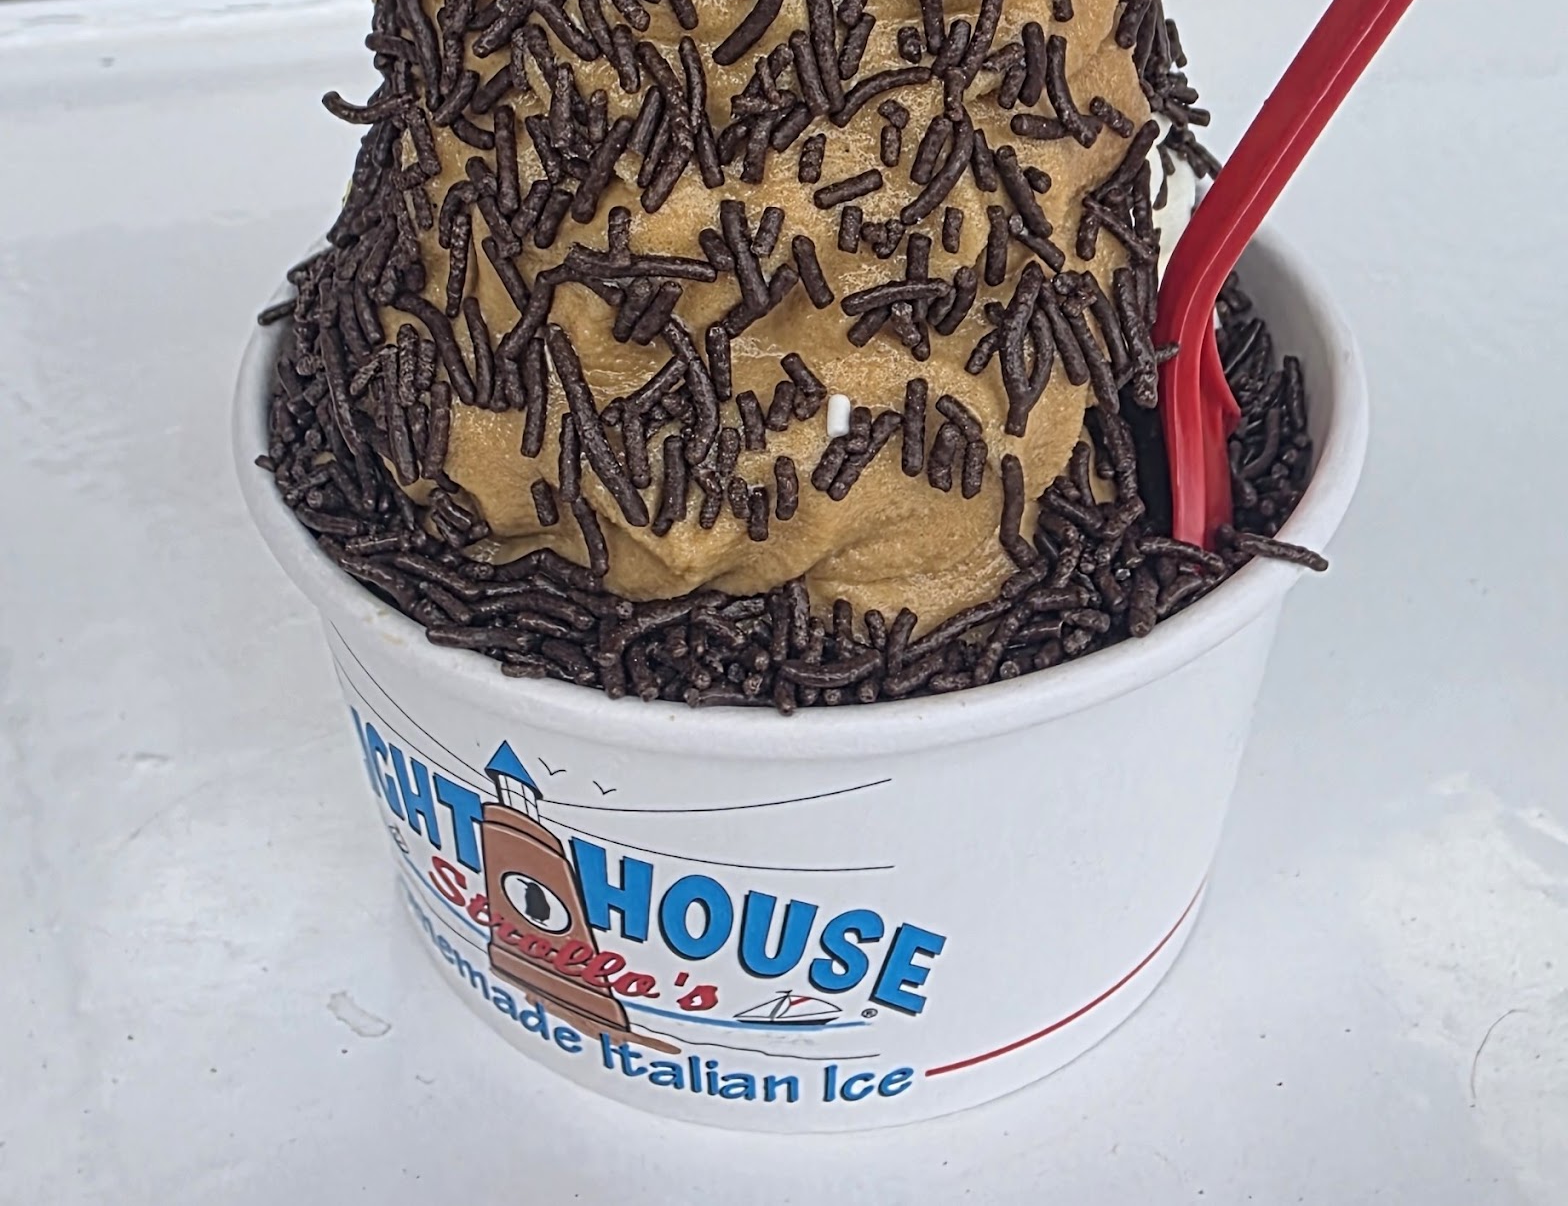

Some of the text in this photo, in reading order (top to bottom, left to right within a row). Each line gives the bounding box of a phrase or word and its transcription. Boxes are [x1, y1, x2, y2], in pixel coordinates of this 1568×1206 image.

[350, 705, 947, 1017] IGHT HOUSE
[429, 856, 719, 1012] Strollo's
[599, 1033, 799, 1104] Italian
[822, 1064, 915, 1102] Ice
